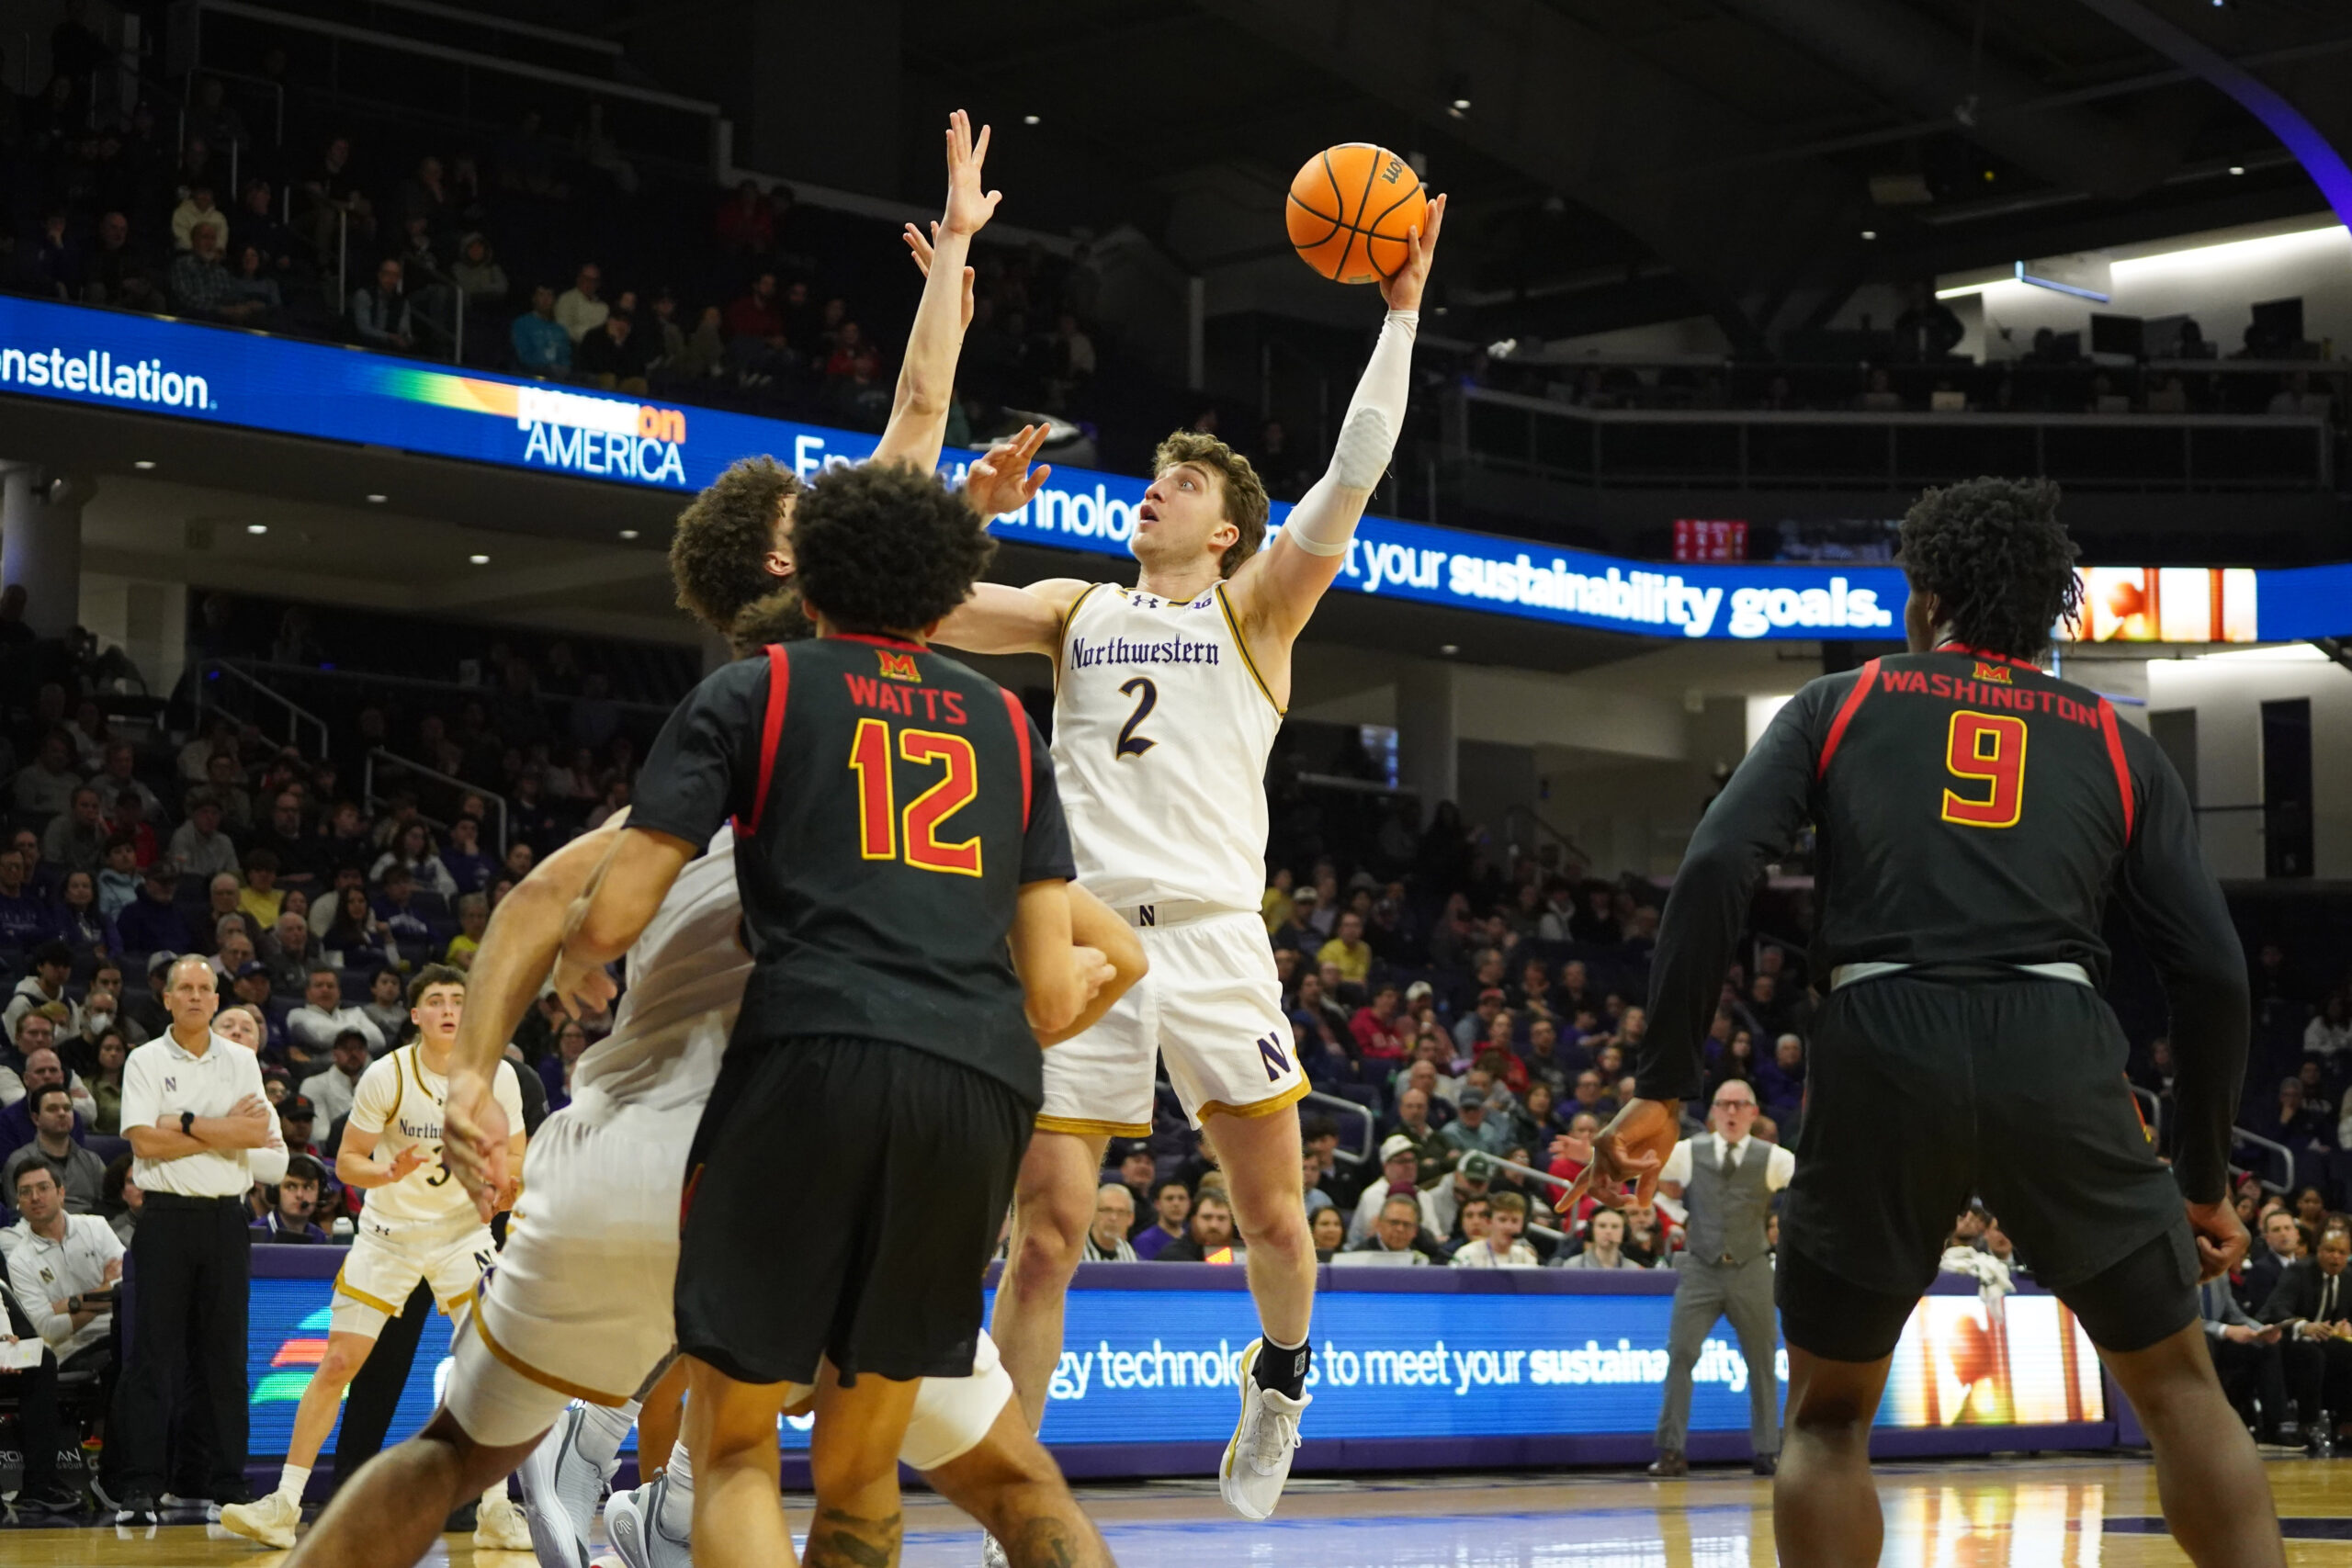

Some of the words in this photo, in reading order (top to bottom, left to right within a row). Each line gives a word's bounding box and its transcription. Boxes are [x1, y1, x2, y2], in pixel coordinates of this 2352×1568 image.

[0, 347, 209, 410] nstellation
[524, 420, 686, 485] AMERICA
[1363, 540, 1447, 592] your
[1449, 553, 1724, 637] sustainability
[1728, 577, 1893, 638] goals.
[1071, 633, 1220, 671] Northwestern
[843, 672, 967, 726] WATTS
[1116, 676, 1159, 761] 2
[1882, 671, 2098, 729] WASHINGTON
[848, 717, 982, 878] 12
[1941, 710, 2028, 828] 9
[1139, 905, 1155, 926] N
[164, 1077, 177, 1092] N
[1257, 1032, 1291, 1082] N
[1323, 1340, 1360, 1386] to
[1364, 1340, 1452, 1385] meet
[1453, 1350, 1526, 1395] your
